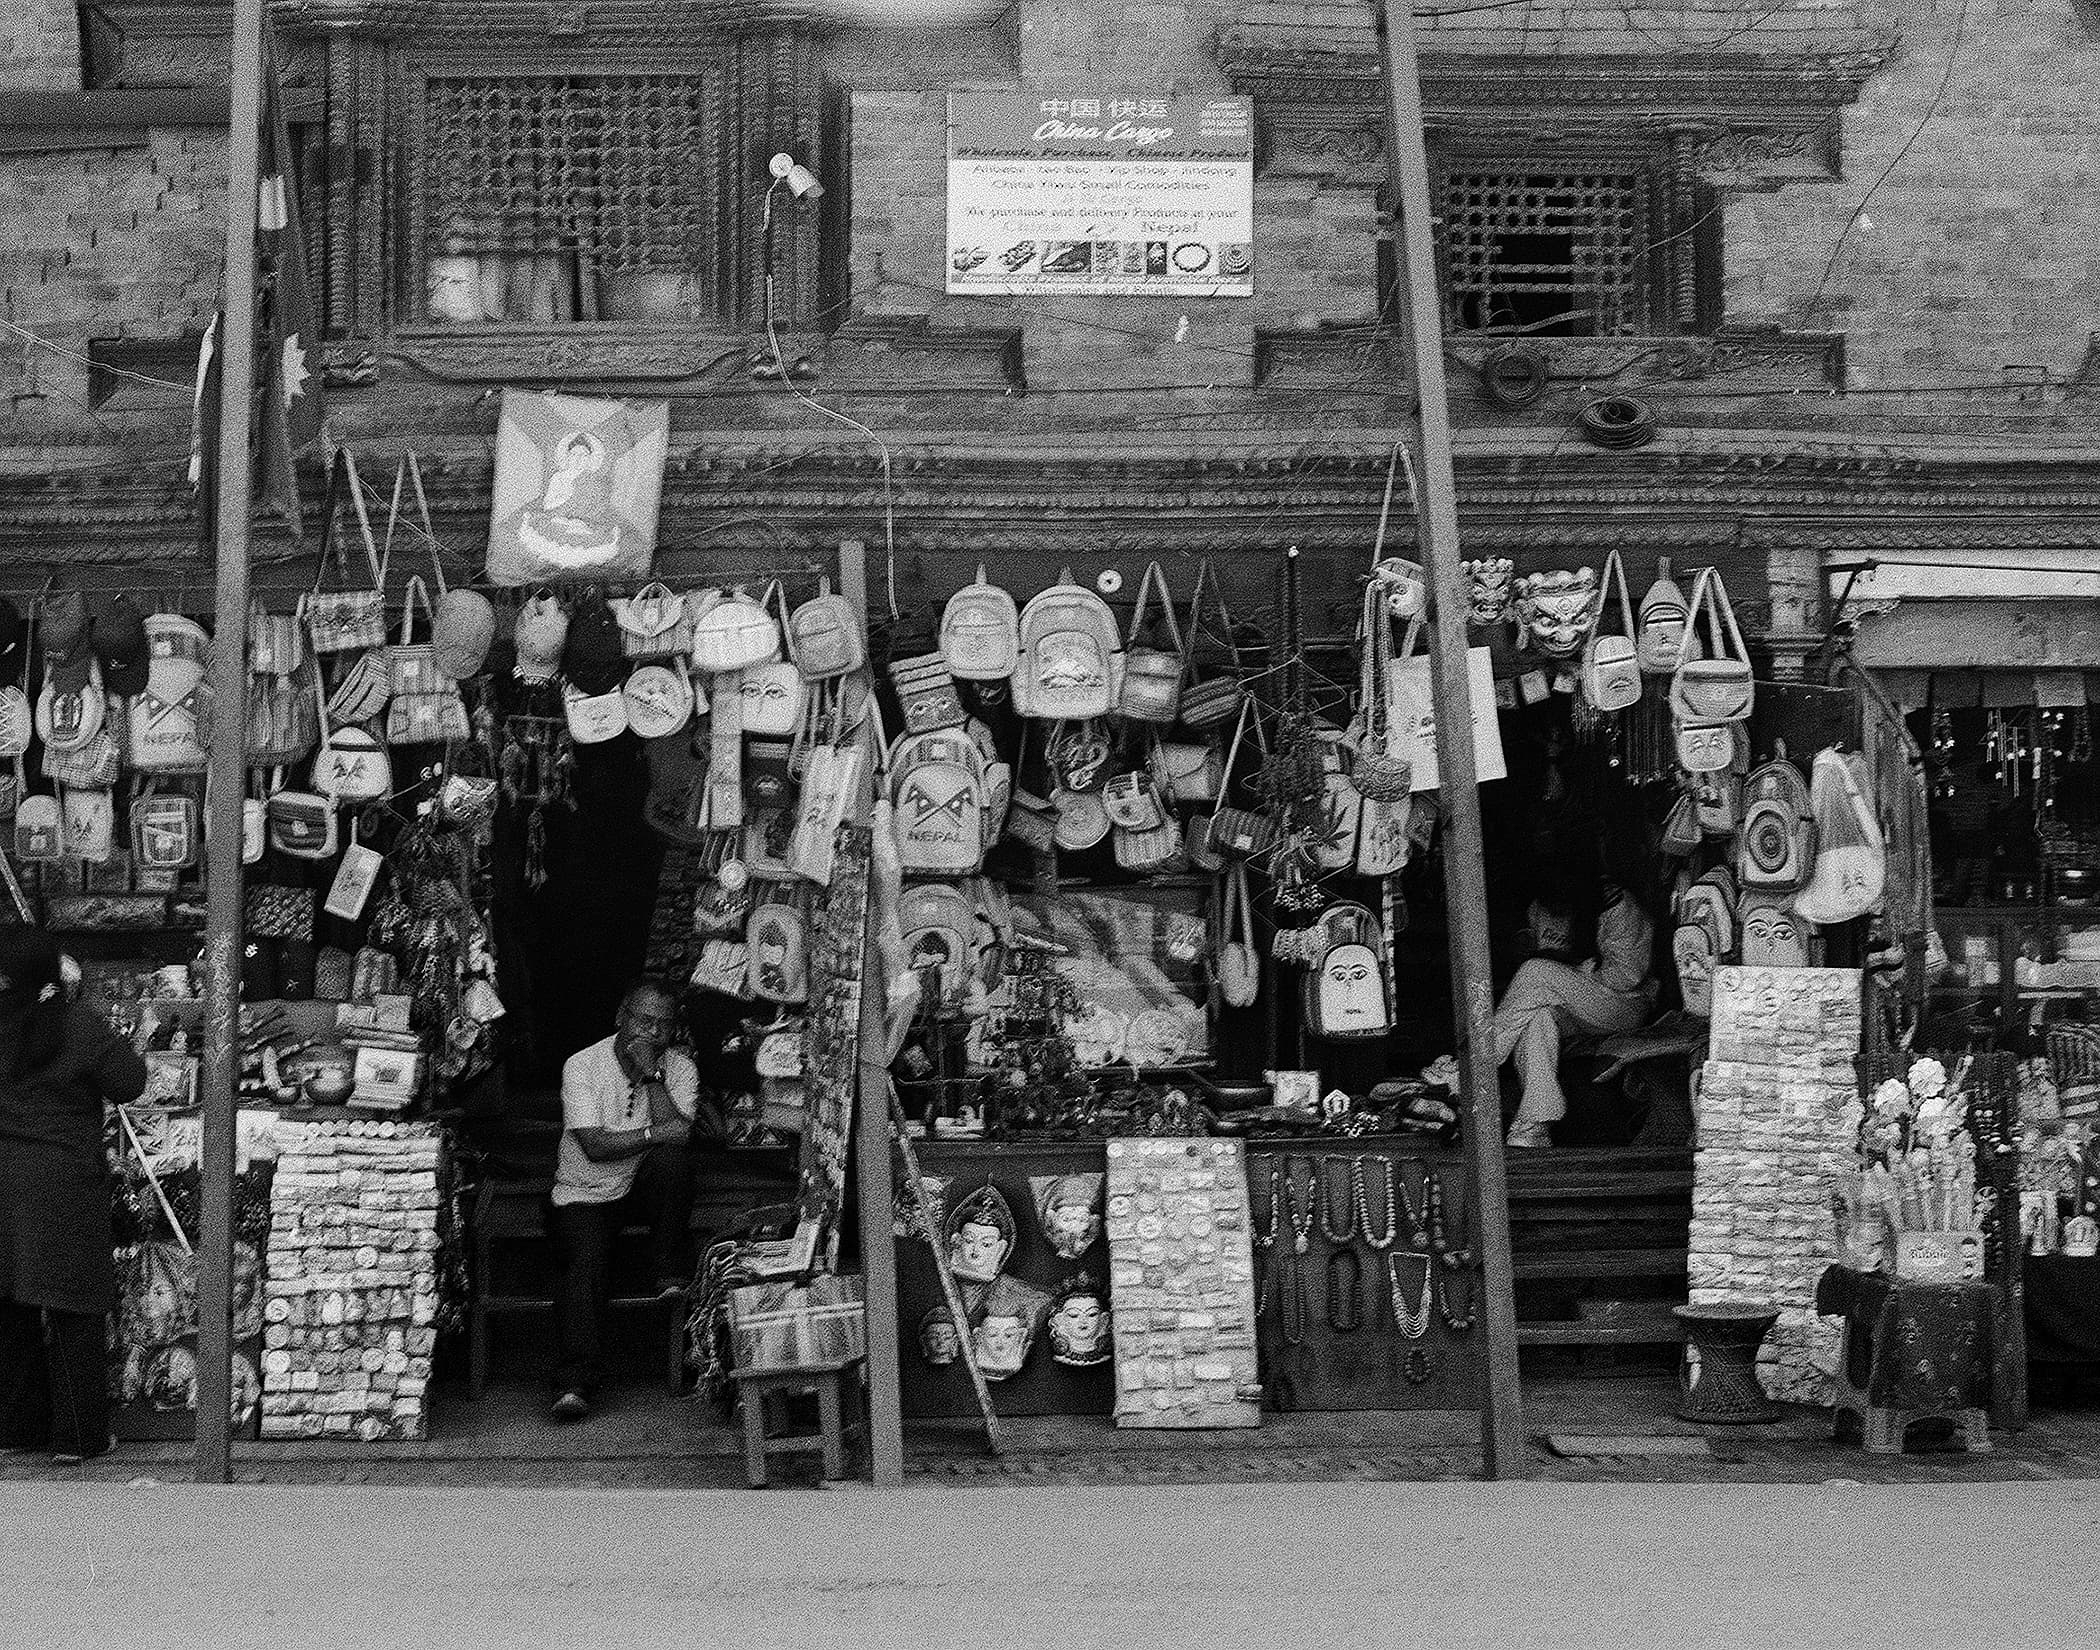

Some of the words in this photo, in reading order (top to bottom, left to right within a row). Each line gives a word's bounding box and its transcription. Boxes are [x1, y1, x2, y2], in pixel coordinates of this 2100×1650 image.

[1032, 119, 1103, 142] China
[1103, 120, 1174, 147] Cargo
[1080, 179, 1121, 190] Small
[1051, 207, 1074, 217] and
[1140, 221, 1199, 236] Nepal
[143, 731, 197, 746] NEPA
[907, 829, 965, 843] NEPAL
